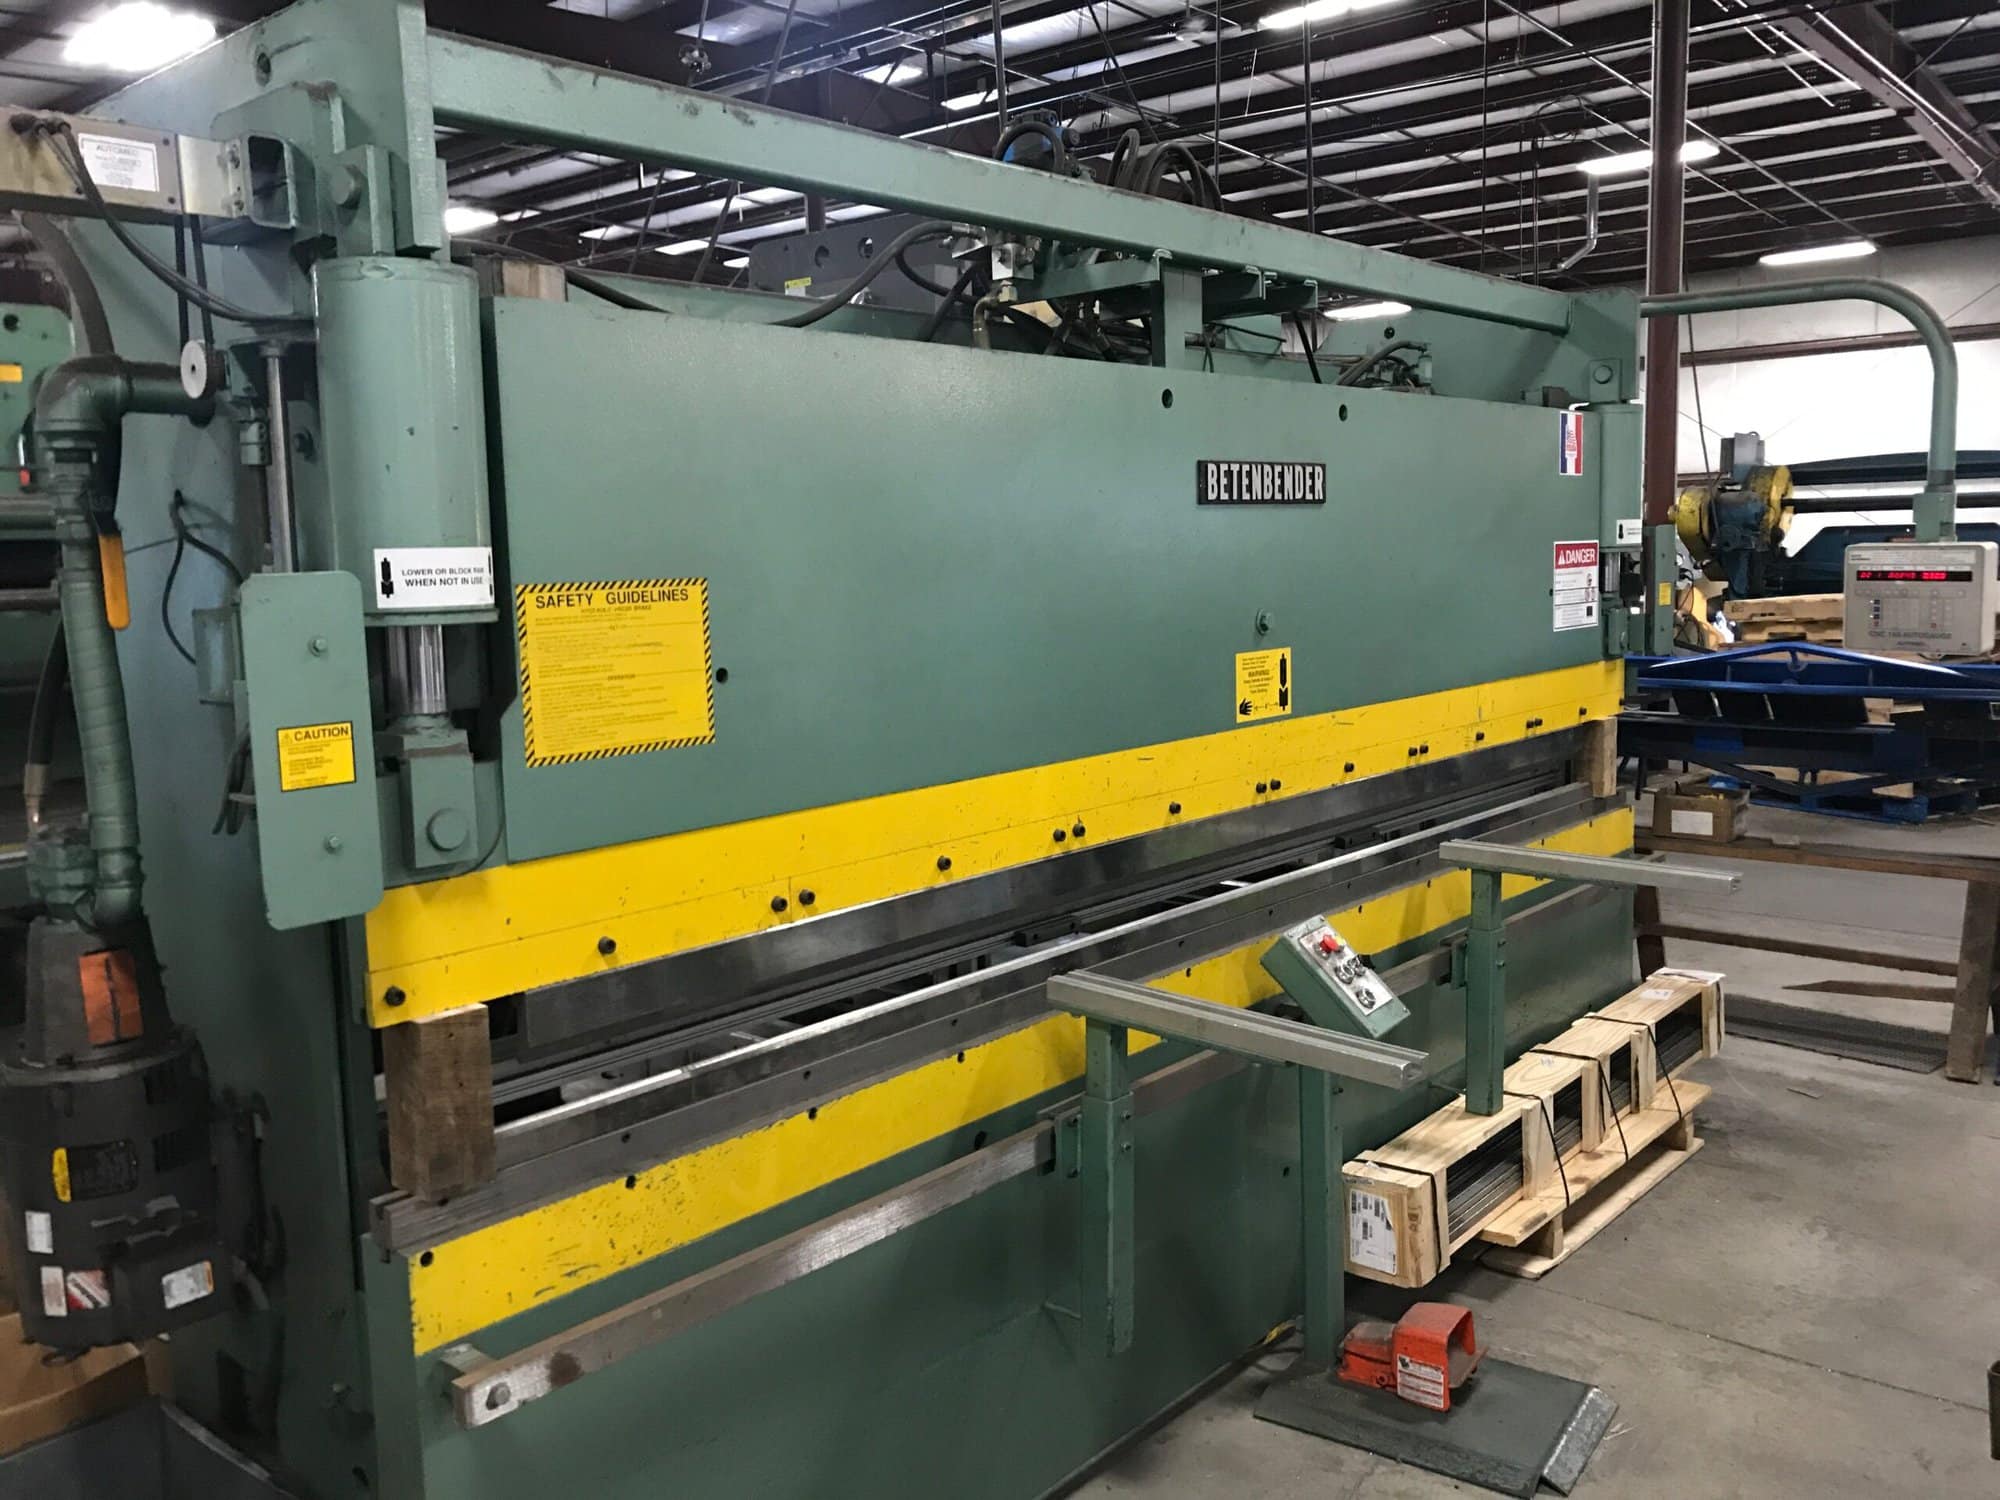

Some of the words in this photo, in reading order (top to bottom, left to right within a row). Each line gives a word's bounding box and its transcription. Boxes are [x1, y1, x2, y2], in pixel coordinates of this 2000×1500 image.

[1207, 463, 1323, 500] BETENBENDER
[1565, 548, 1596, 564] DANGER
[401, 568, 433, 576] LOWER
[449, 567, 471, 575] BLOCK
[405, 578, 437, 587] WHEN
[440, 577, 458, 586] NOT
[461, 577, 469, 585] IN
[471, 577, 483, 585] USE
[535, 593, 593, 609] SAFETY
[606, 589, 689, 605] GUIDELINES
[294, 726, 349, 741] CAUTION
